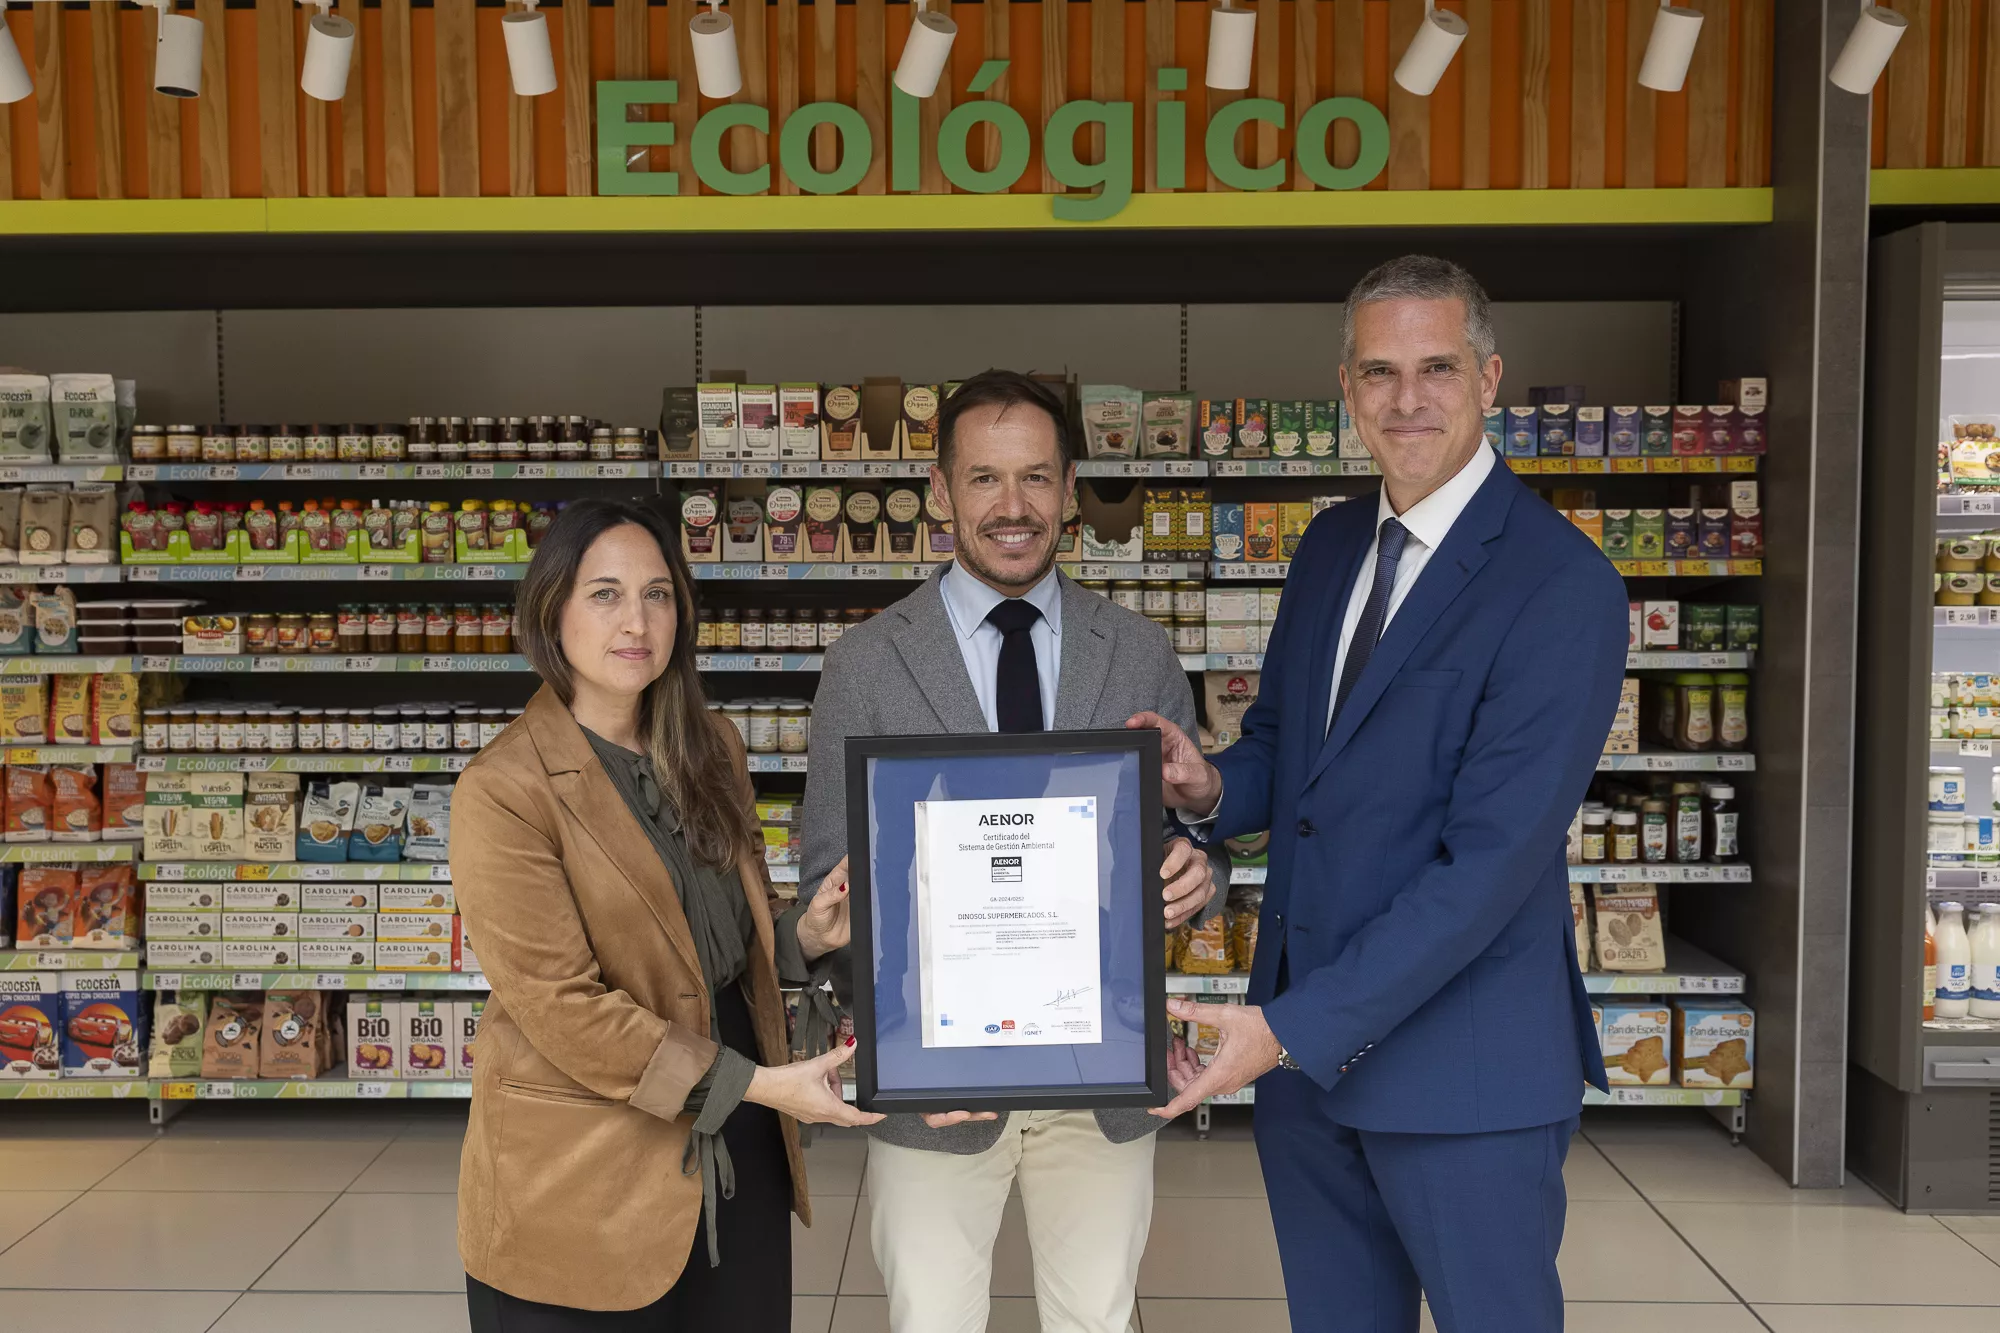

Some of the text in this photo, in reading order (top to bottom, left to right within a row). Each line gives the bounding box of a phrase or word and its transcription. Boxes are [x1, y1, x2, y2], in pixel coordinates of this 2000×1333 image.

[597, 60, 1390, 221] Ecológico
[1102, 410, 1122, 419] Chips
[1176, 466, 1191, 474] 4,59
[1353, 464, 1368, 472] 3,49
[280, 566, 340, 580] Organic
[1230, 567, 1245, 575] 3,49
[20, 658, 79, 672] Organic
[174, 656, 245, 673] Ecológico
[450, 658, 509, 671] cológico
[286, 757, 344, 772] Organic
[979, 813, 1034, 826] AENOR
[983, 833, 1019, 841] Certificado
[1020, 841, 1055, 849] Ambiental
[20, 846, 80, 862] Organic
[149, 886, 200, 894] CAROLINA
[304, 887, 356, 895] CAROLINA
[301, 916, 353, 924] CAROLINA
[0, 981, 42, 992] COCESTA
[75, 979, 121, 990] ECOCESTA
[1607, 1025, 1666, 1035] Pan de Espelta
[1690, 1027, 1749, 1038] Pan de Espelta
[37, 1083, 95, 1098] Organic
